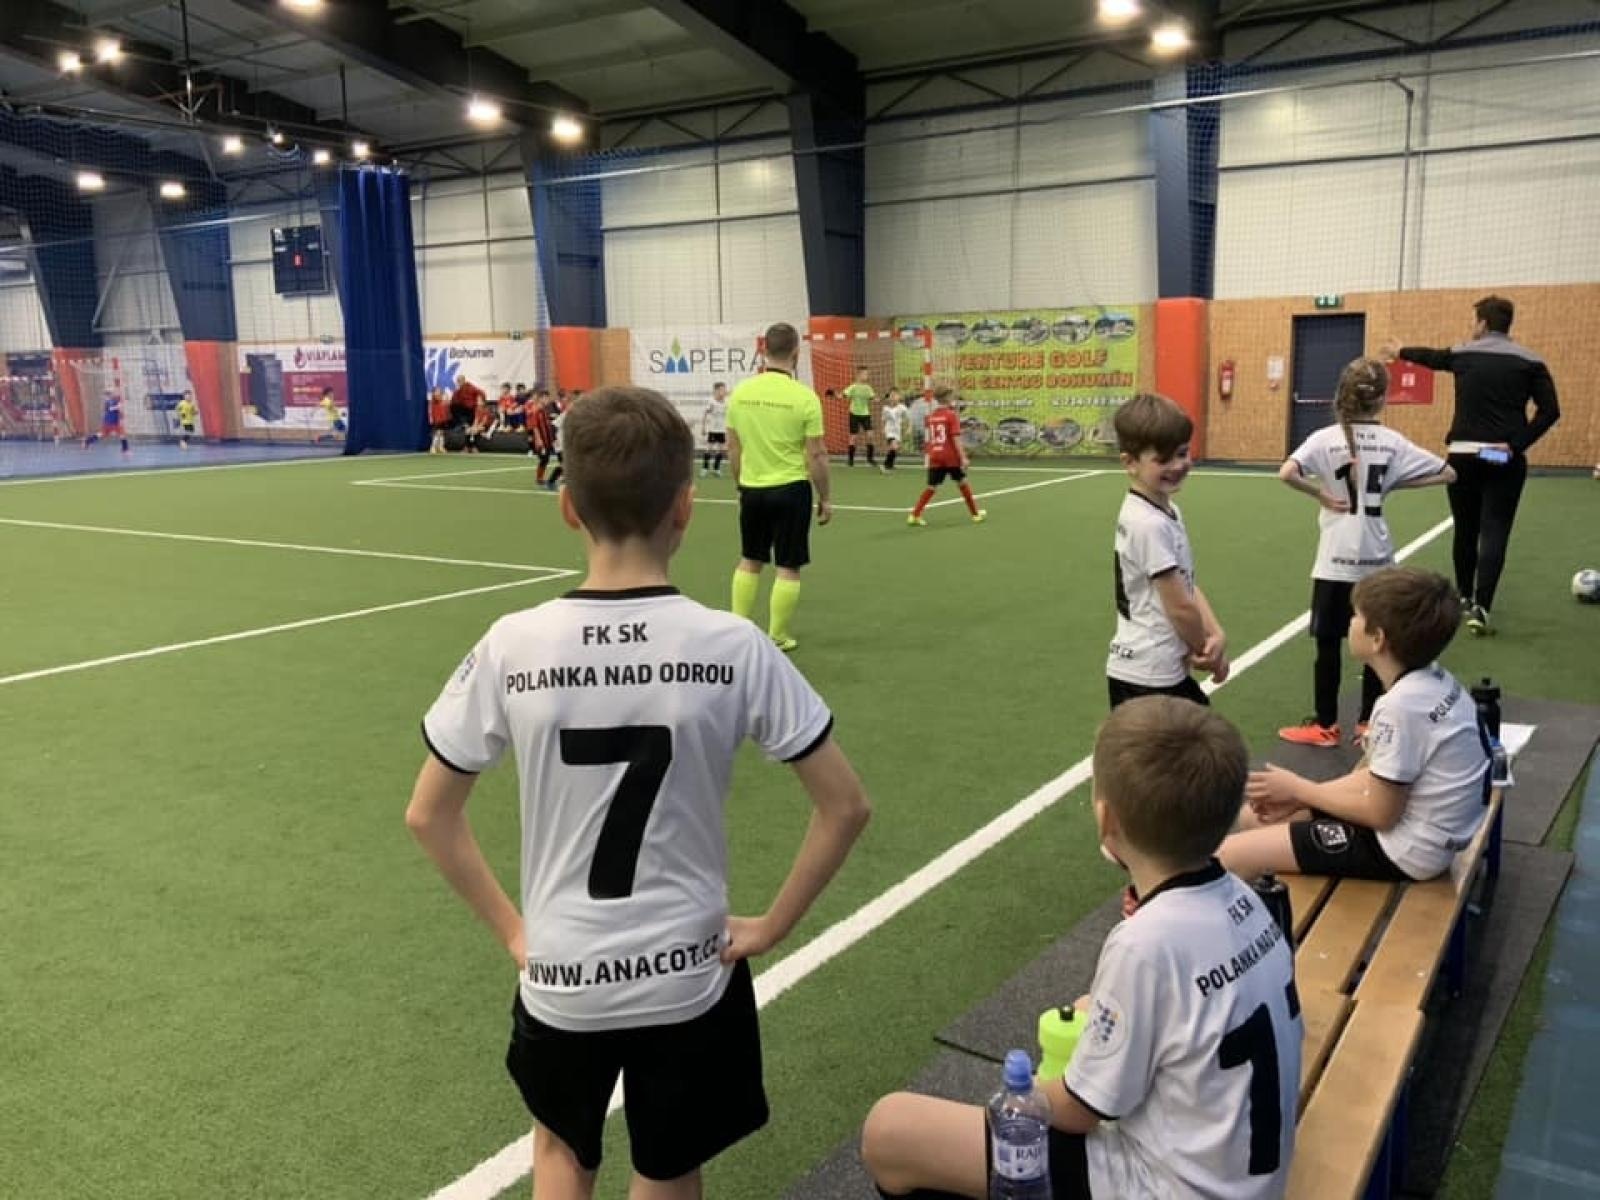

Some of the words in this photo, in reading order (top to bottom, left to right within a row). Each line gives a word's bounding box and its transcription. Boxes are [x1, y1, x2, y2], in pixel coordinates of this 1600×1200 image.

[1050, 348, 1108, 368] GOLF
[929, 423, 947, 445] 13
[1334, 462, 1390, 517] 15
[582, 624, 611, 646] FK
[619, 622, 648, 643] SK
[505, 665, 597, 695] POLANKA
[604, 664, 651, 687] NAD
[659, 662, 735, 686] ODROU
[559, 725, 673, 901] 7
